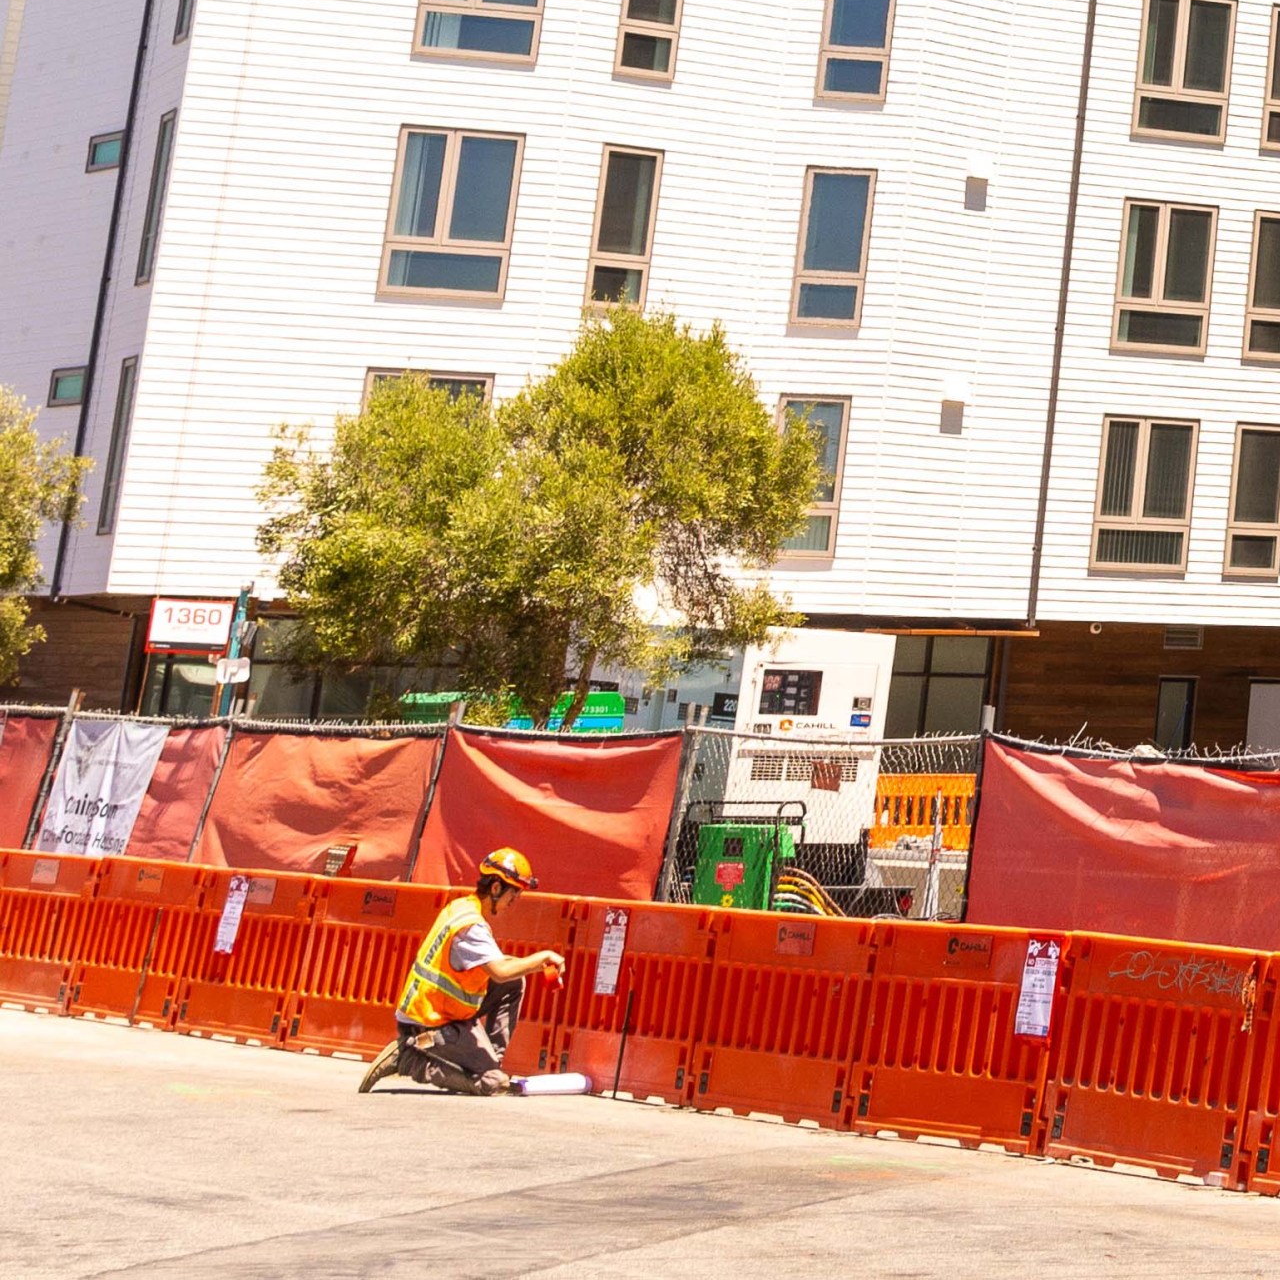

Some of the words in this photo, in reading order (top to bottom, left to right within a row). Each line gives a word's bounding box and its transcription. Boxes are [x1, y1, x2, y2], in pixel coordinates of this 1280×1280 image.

[164, 606, 222, 626] 1360
[795, 722, 837, 730] CAHILL
[959, 942, 989, 952] CAHILL
